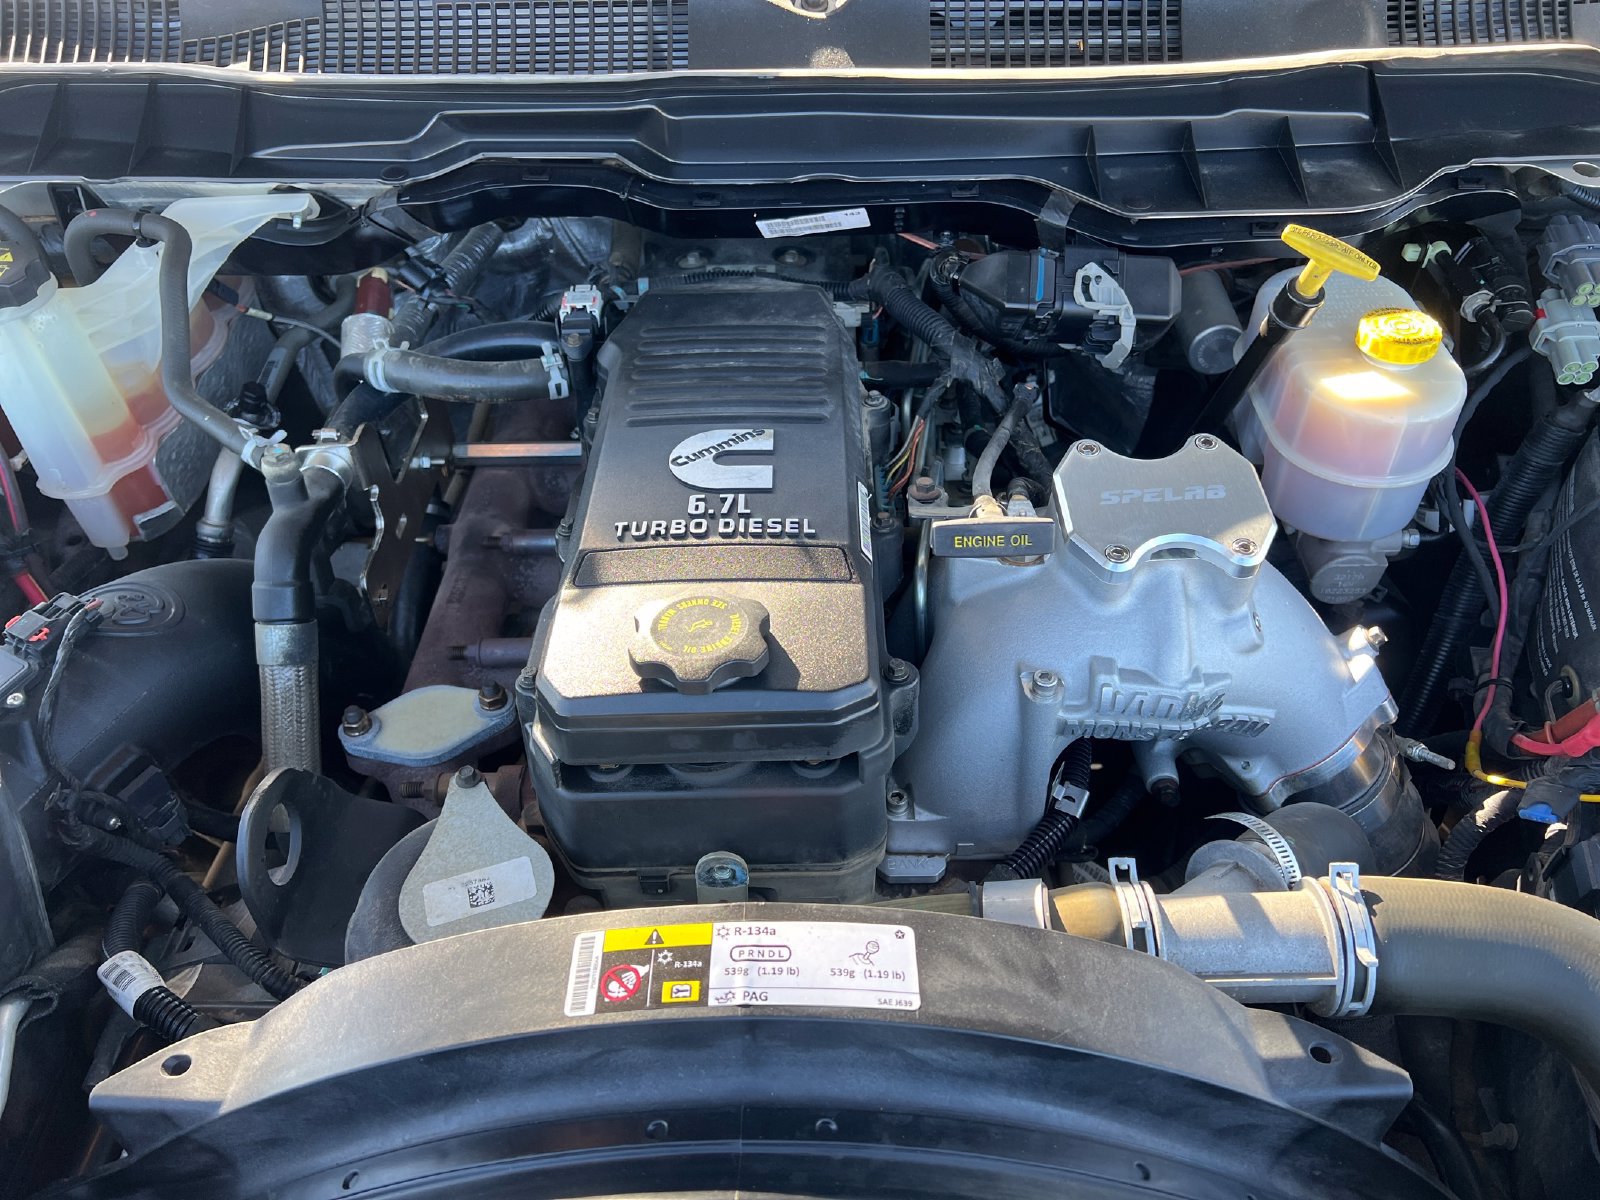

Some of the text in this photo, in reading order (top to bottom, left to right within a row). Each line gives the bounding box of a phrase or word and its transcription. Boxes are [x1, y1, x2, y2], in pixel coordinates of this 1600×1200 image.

[670, 428, 766, 467] Cummins
[1100, 484, 1226, 505] SPELAB
[687, 493, 751, 516] 6.7L
[614, 517, 816, 538] TURBO DIESEL
[954, 534, 1033, 548] ENGINE OIL
[683, 644, 698, 654] OIL
[734, 926, 776, 936] R-134a
[674, 960, 703, 969] R-134a
[724, 966, 800, 977] 539g (1.19 lb)
[830, 967, 906, 982] 539g (1.19 lb)
[743, 990, 769, 1002] PAG
[877, 998, 913, 1008] SAE J639
